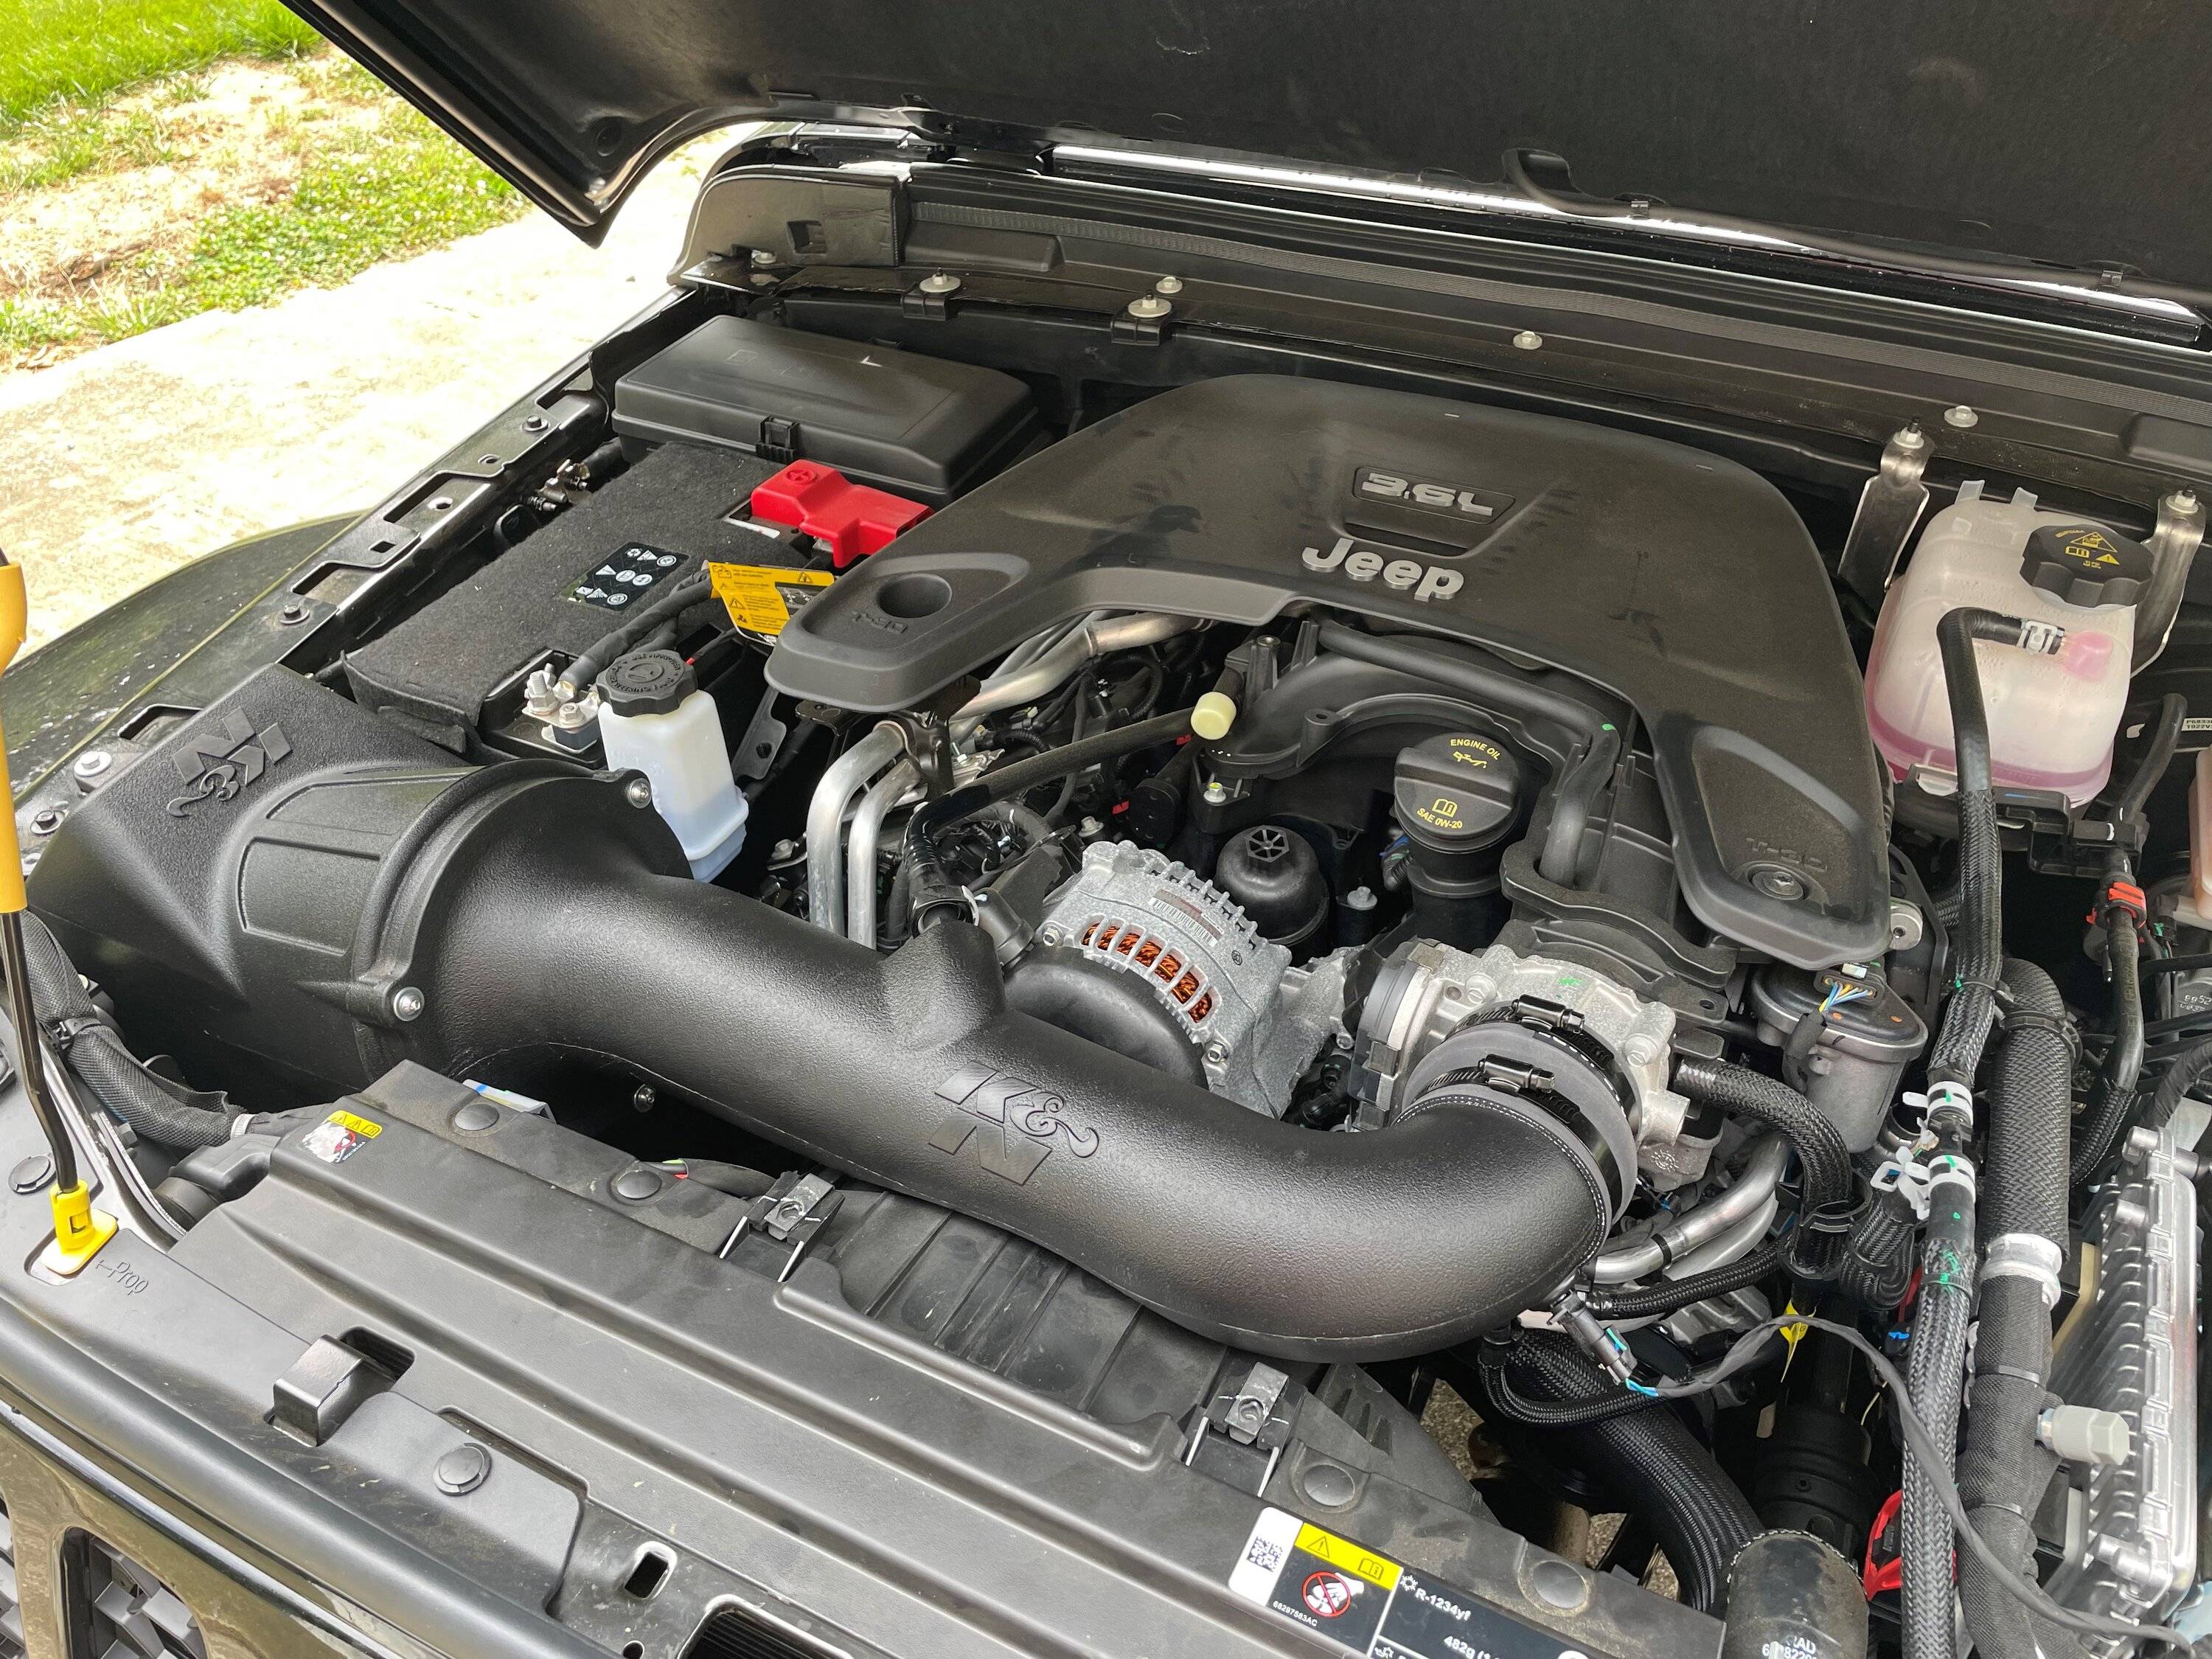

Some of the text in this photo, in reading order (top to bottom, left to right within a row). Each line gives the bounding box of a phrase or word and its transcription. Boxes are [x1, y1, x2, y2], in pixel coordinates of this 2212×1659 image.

[1362, 473, 1493, 516] 3.6L
[1302, 538, 1464, 602] Jeep
[166, 706, 293, 818] K&N
[1450, 739, 1501, 761] ENGINE OIL
[1416, 807, 1464, 830] SAE 0W-20
[928, 1060, 1099, 1186] K&N
[107, 1262, 149, 1296] Prop
[1415, 1587, 1472, 1621] R-1234yf
[1443, 1635, 1475, 1659] 482g
